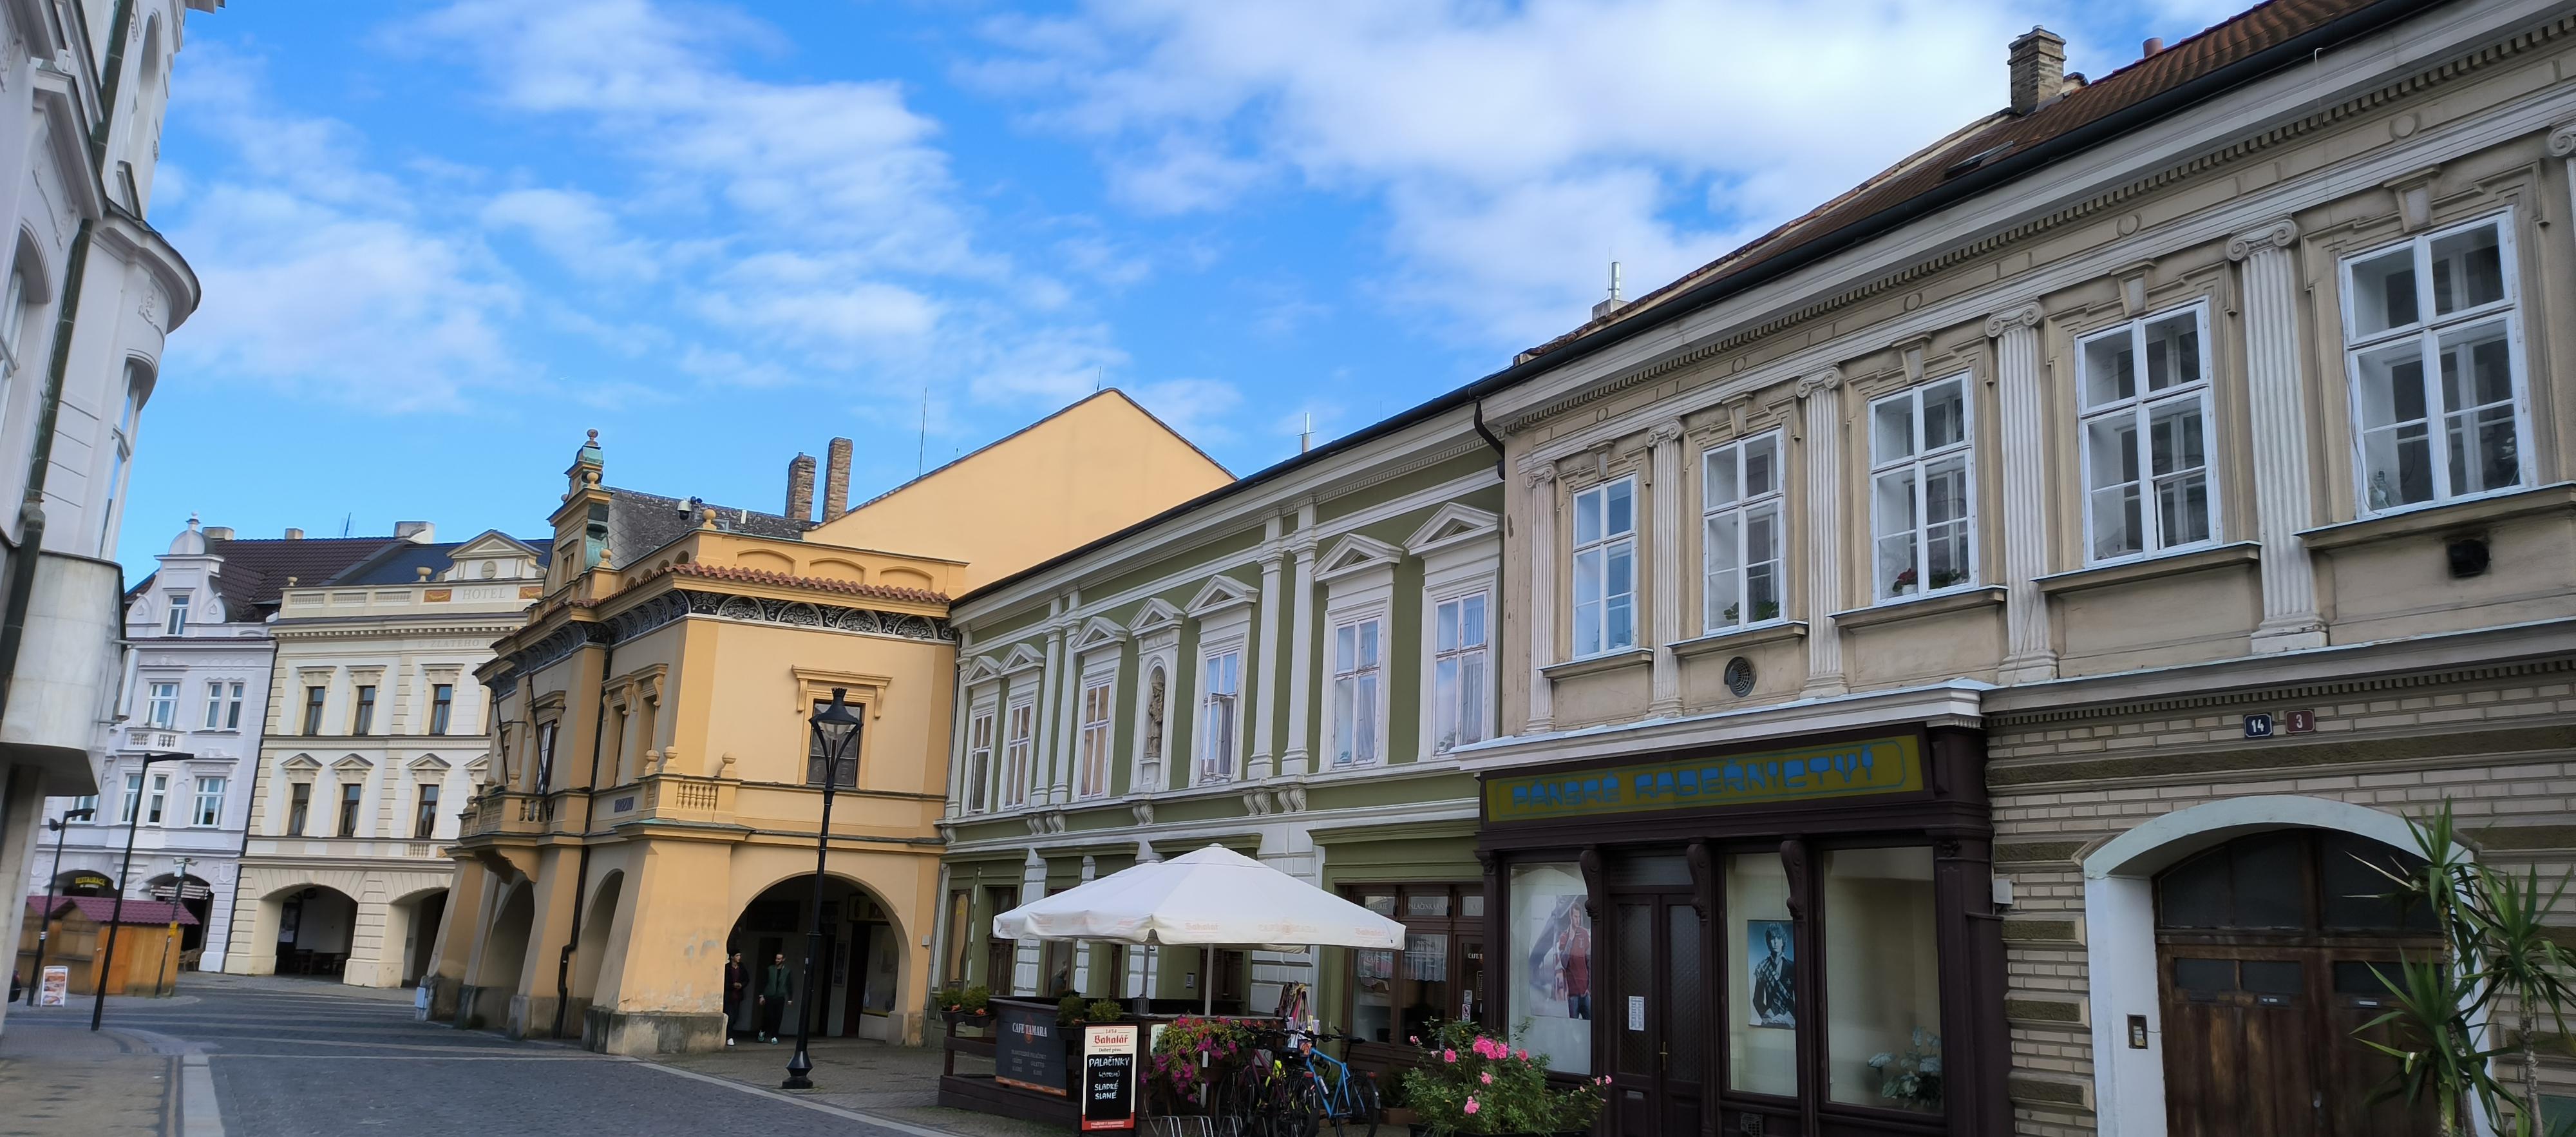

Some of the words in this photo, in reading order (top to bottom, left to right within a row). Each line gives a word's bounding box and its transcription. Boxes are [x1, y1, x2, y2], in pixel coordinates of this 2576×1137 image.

[462, 588, 506, 600] HOTEL
[430, 638, 480, 648] ZLATÉHO
[2251, 718, 2265, 733] 14
[2295, 713, 2304, 729] 3
[1025, 1024, 1047, 1037] TAMARA
[1093, 1035, 1128, 1044] Bakalář
[1088, 1056, 1130, 1068] PALAČINKY
[1094, 1080, 1119, 1091] SLADKÉ
[1095, 1090, 1118, 1100] SLANÉ
